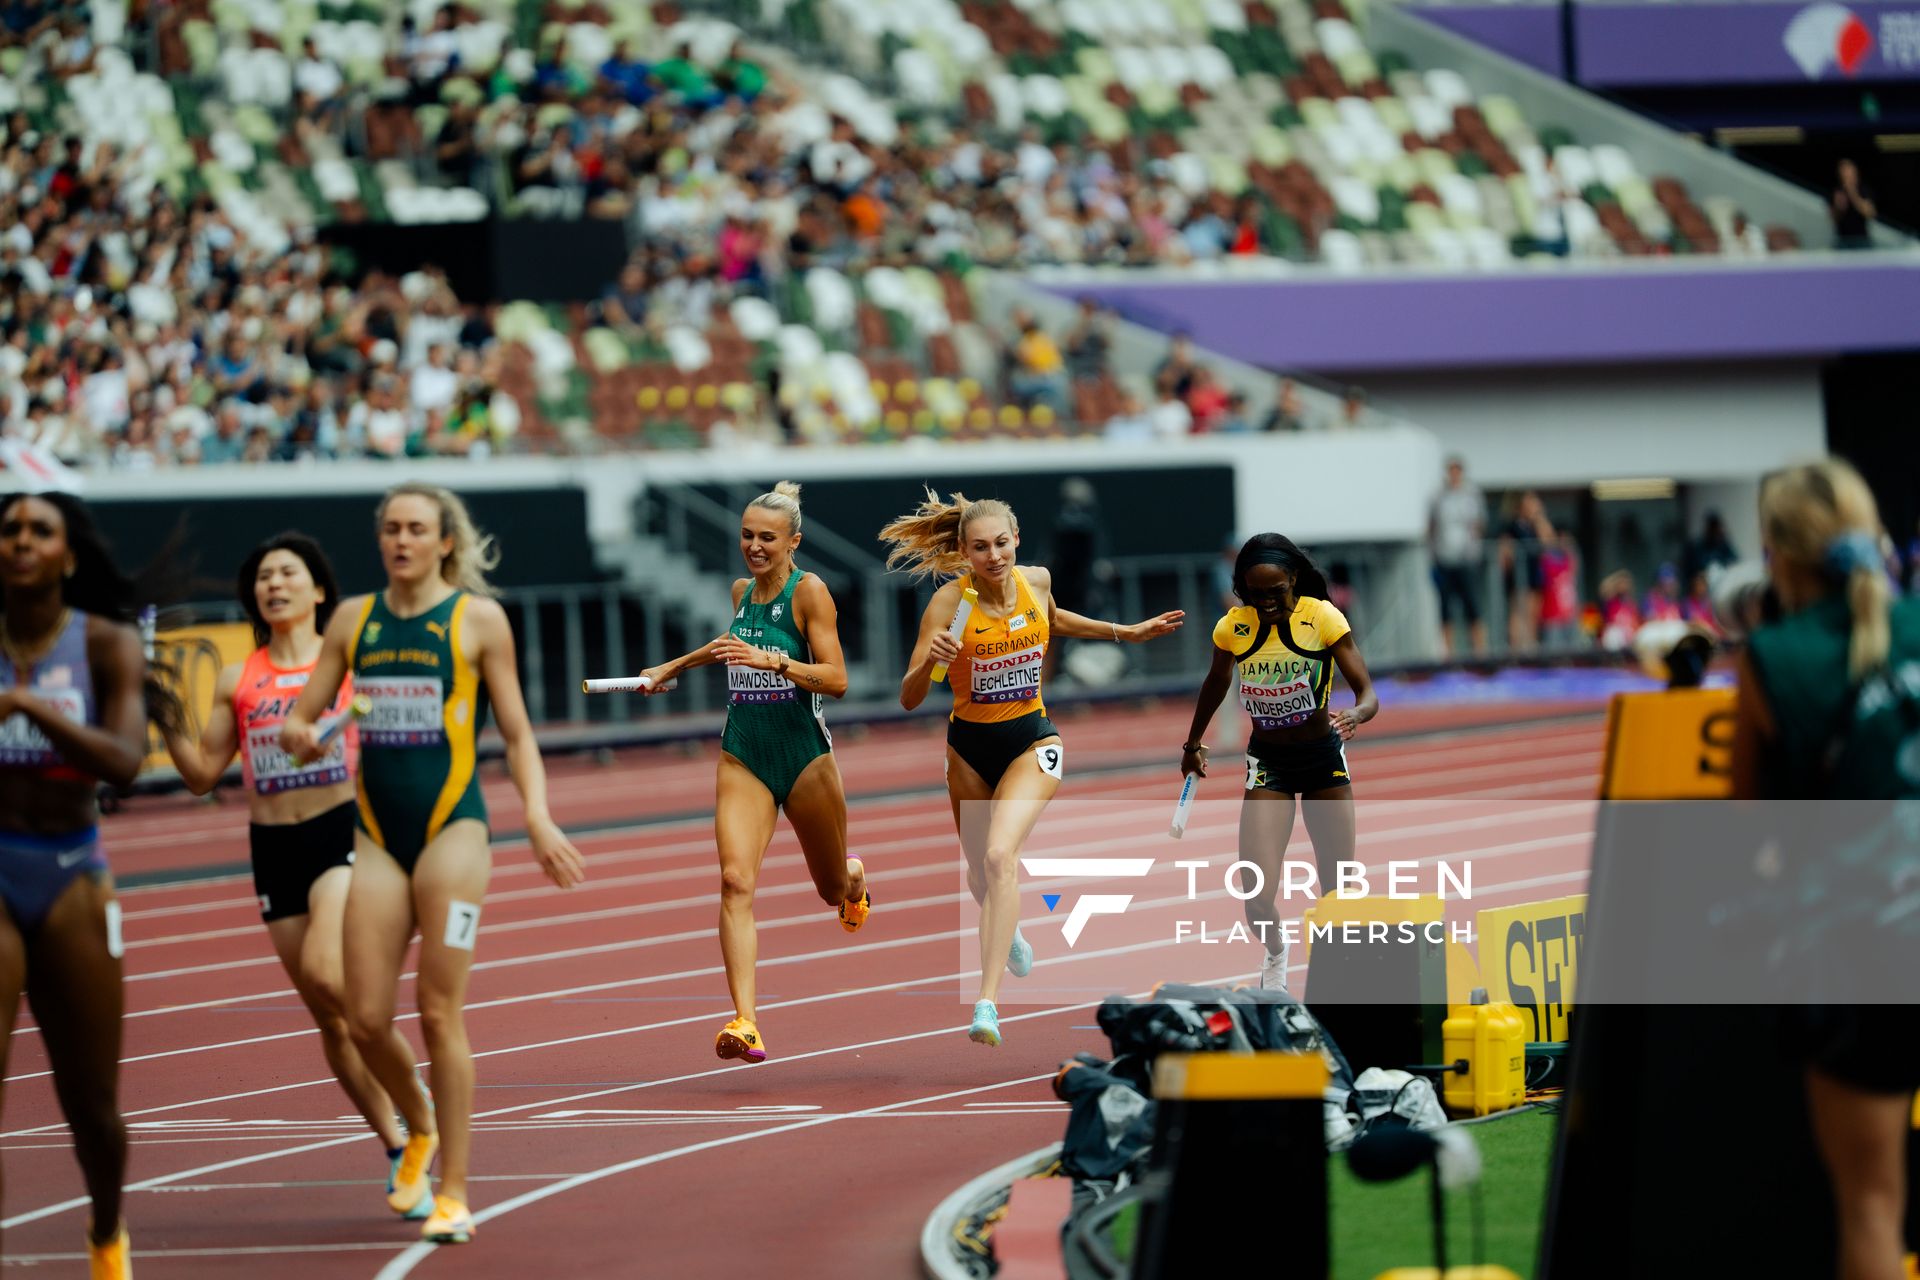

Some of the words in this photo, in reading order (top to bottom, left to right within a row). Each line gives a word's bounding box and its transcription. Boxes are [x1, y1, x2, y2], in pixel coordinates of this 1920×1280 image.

[975, 631, 1041, 655] GERMANY
[974, 651, 1042, 672] HONDA
[1242, 661, 1312, 676] JAMAICA
[731, 671, 789, 688] MAWDSLEY
[1241, 682, 1308, 697] HONDA
[1246, 693, 1312, 716] ANDERSON
[1045, 748, 1058, 770] 9
[459, 911, 473, 941] 7
